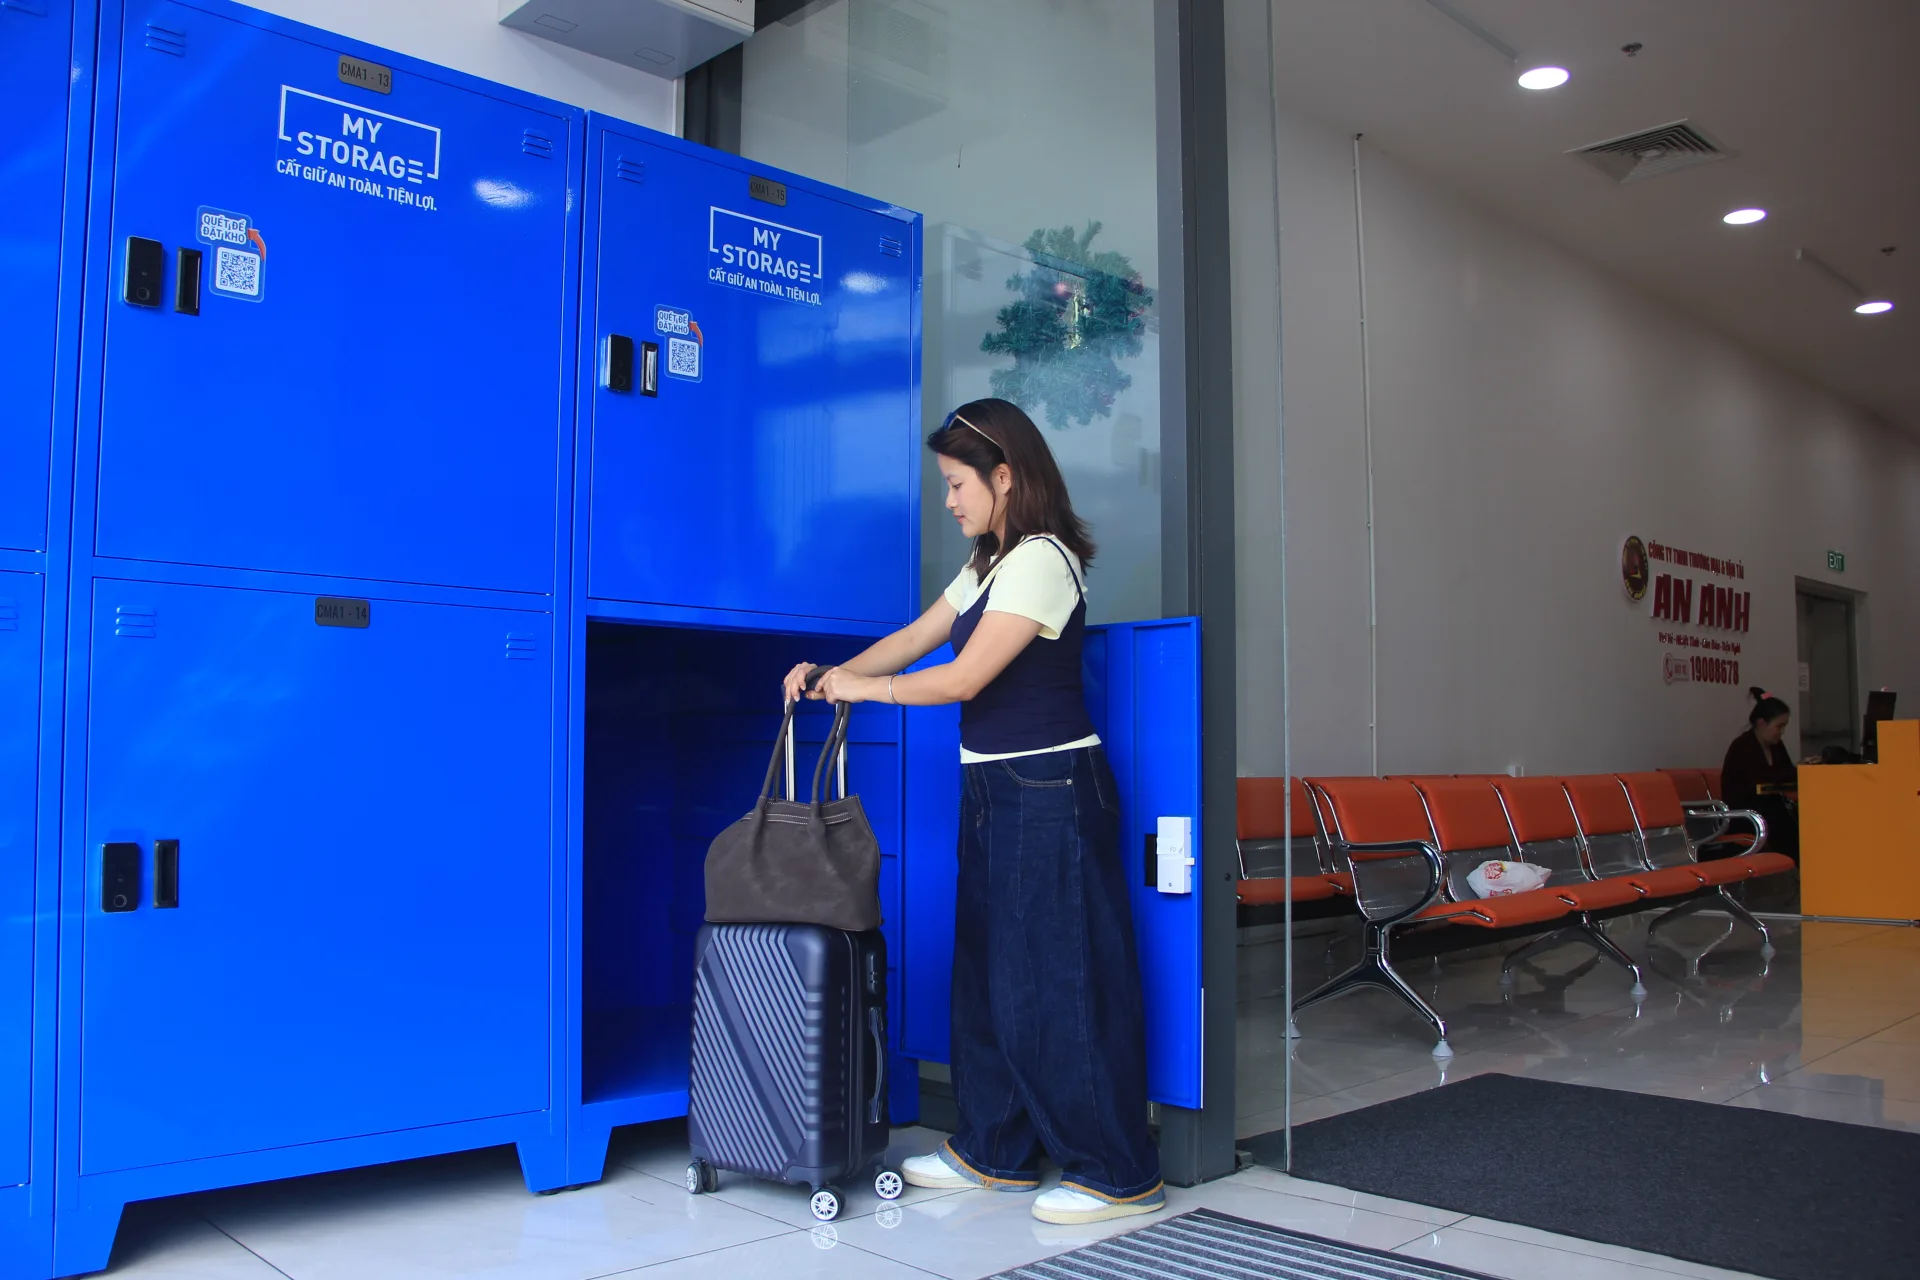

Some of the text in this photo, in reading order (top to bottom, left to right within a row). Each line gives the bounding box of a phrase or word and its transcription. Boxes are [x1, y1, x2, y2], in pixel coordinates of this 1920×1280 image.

[341, 62, 367, 80] CMA1
[378, 72, 389, 87] 13
[342, 112, 383, 144] MY
[296, 131, 424, 184] STORAGE
[276, 158, 437, 211] CẤT GIỮ AN TOÀN. TIỆN LỢI.
[776, 189, 785, 201] 15
[224, 230, 246, 243] KHO
[753, 226, 781, 251] MY
[722, 243, 811, 284] STORAGE
[709, 267, 822, 306] CẤT GIỮ AN TOÀN. TIỆN LỢI.
[674, 324, 689, 334] KHO
[1829, 553, 1843, 570] EXIT
[317, 604, 344, 619] CMA1
[356, 606, 367, 619] 14
[1653, 574, 1750, 633] AN ANH
[1690, 656, 1739, 686] 19008678
